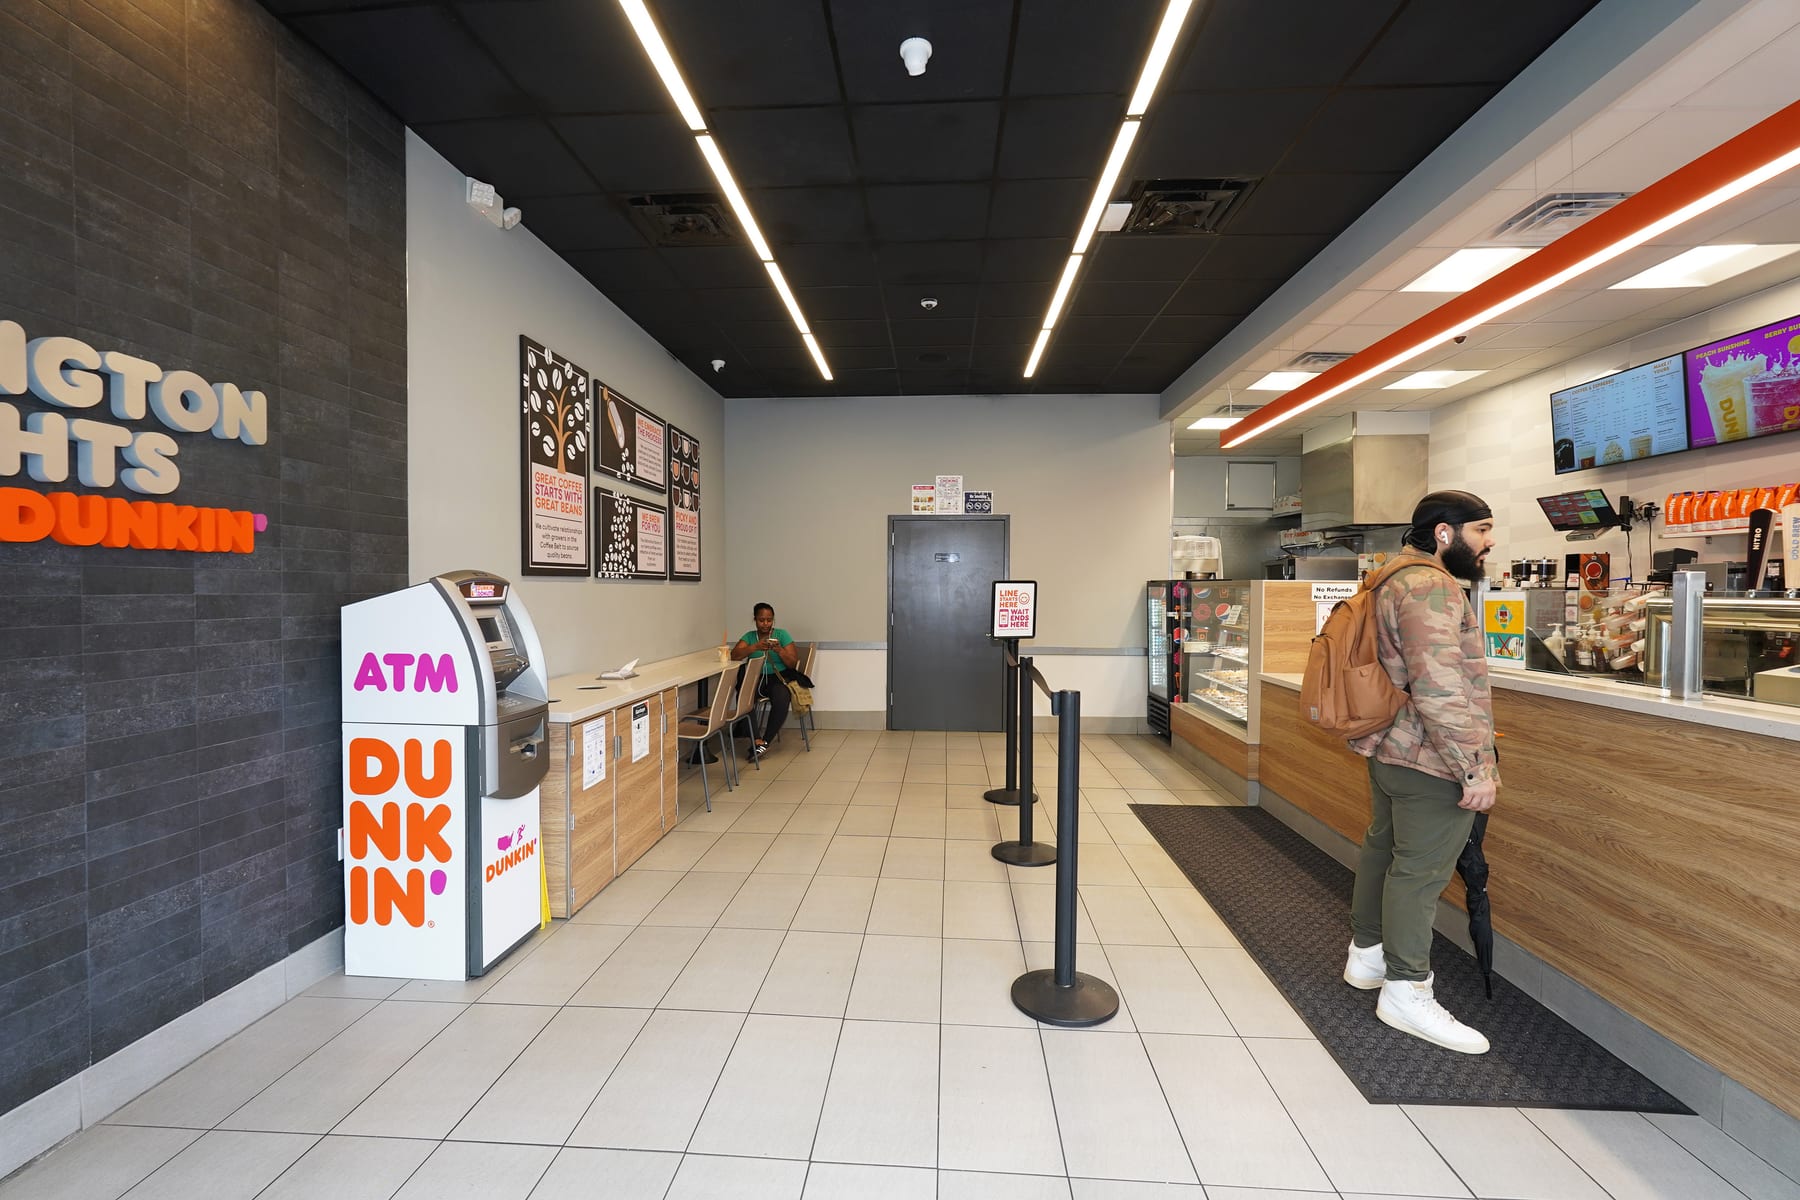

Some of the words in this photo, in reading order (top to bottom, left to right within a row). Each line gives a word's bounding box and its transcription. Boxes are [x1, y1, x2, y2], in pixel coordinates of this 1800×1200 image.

[1764, 327, 1787, 338] BERRY
[1696, 349, 1716, 360] PEACH
[1718, 338, 1751, 353] SUNSHINE
[534, 472, 556, 486] GREAT
[558, 478, 582, 492] COFFEE
[535, 484, 562, 500] STARTS
[564, 490, 582, 504] WITH
[535, 497, 559, 511] GREAT
[561, 502, 582, 516] BEANS
[0, 487, 267, 554] DUNKIN'
[1792, 517, 1800, 538] BREW
[1752, 528, 1762, 550] NITRO
[354, 652, 458, 693] ATM
[349, 738, 452, 798] DU
[349, 800, 452, 863] NK
[486, 838, 537, 883] DUNKIN'
